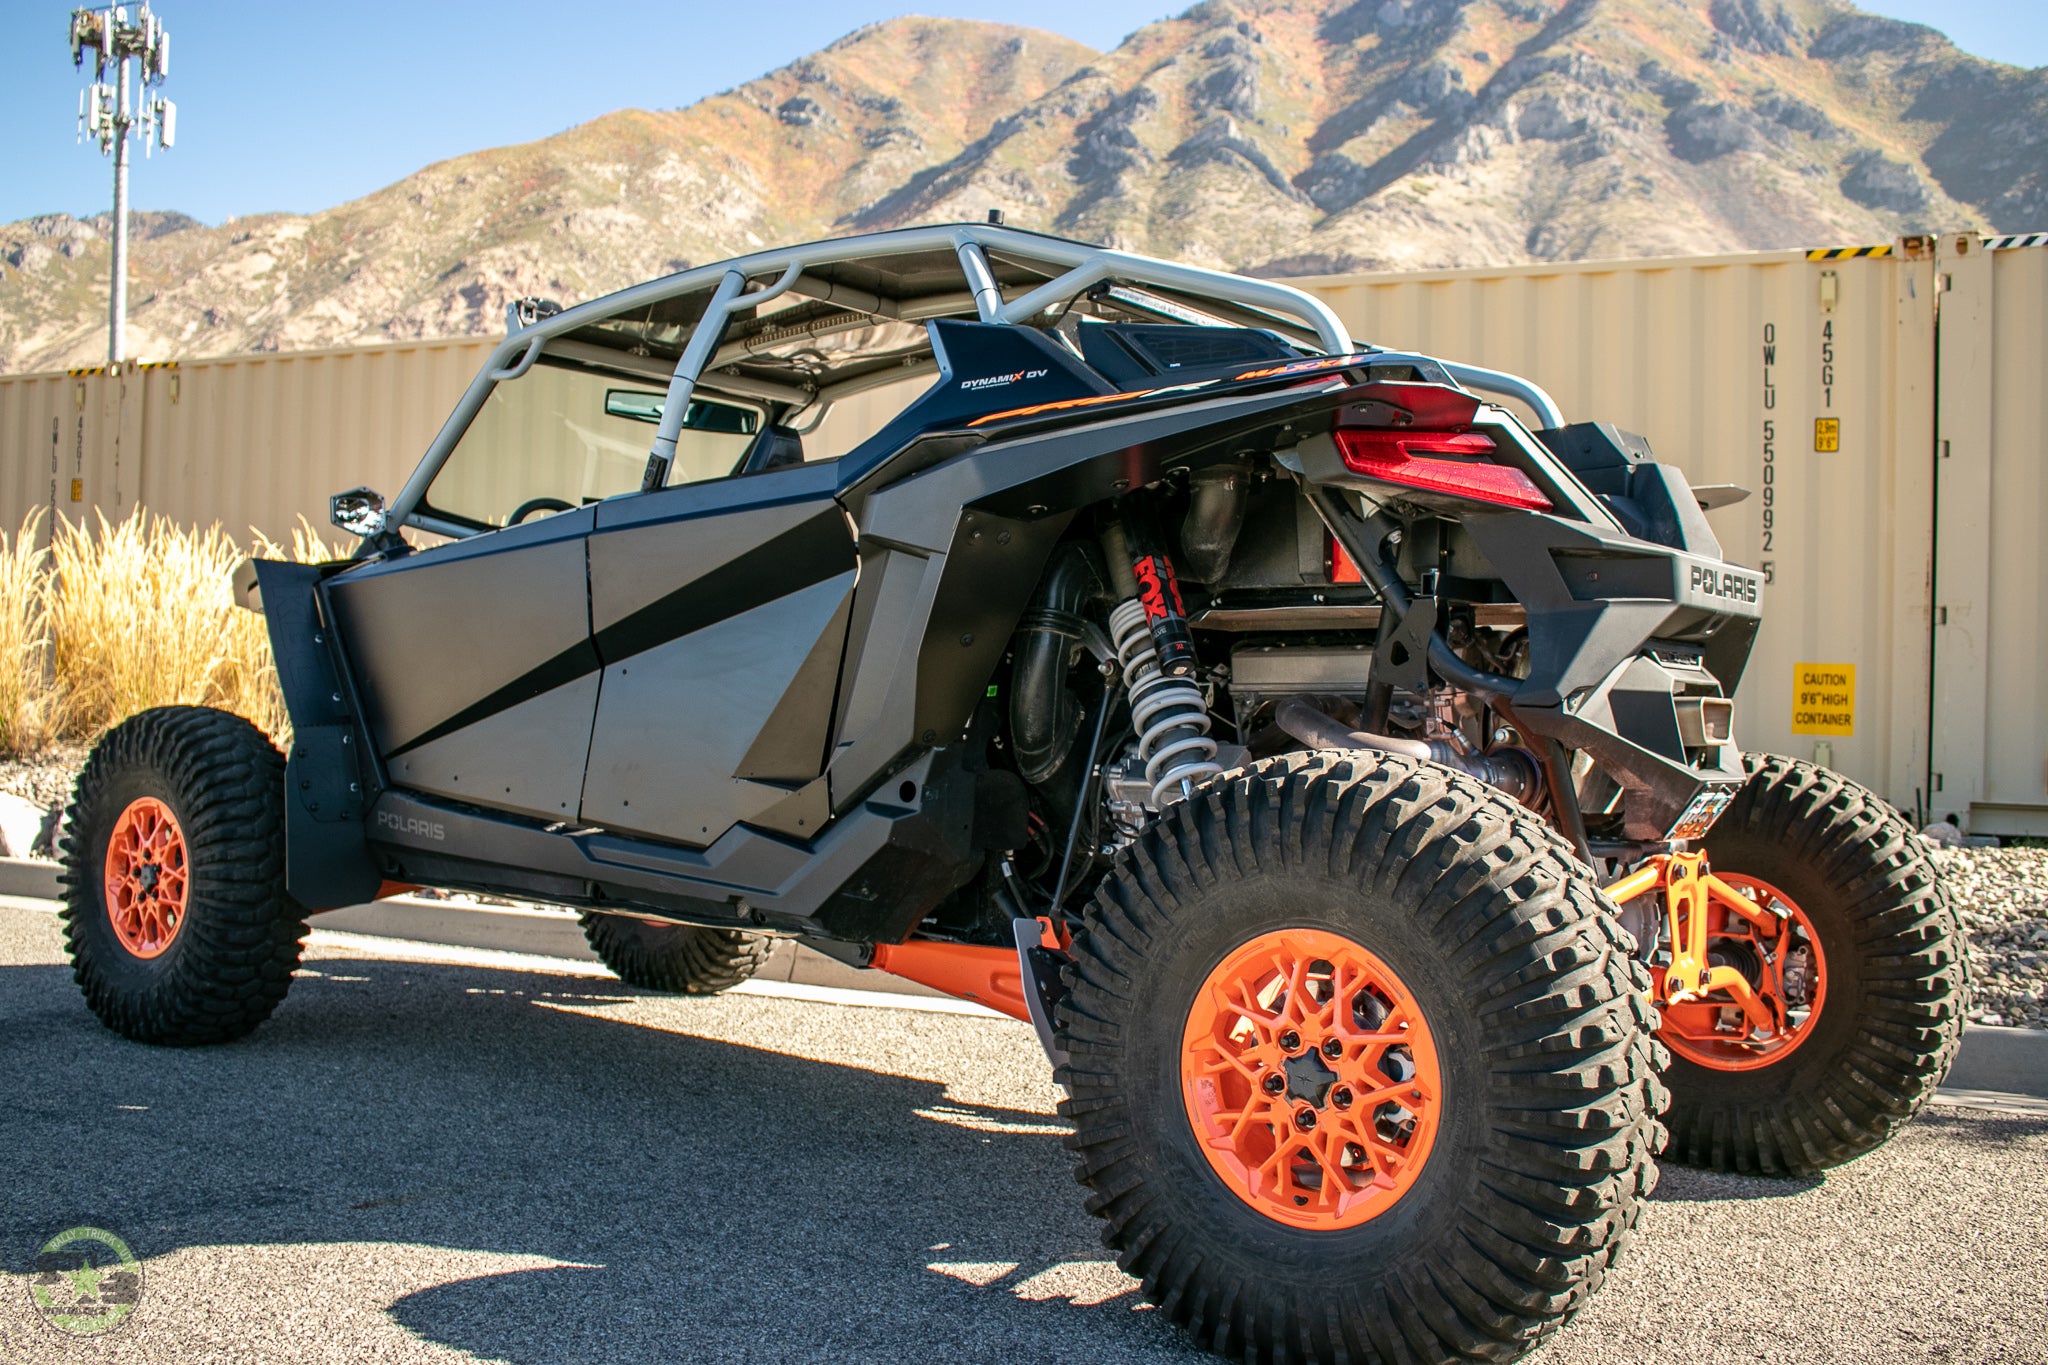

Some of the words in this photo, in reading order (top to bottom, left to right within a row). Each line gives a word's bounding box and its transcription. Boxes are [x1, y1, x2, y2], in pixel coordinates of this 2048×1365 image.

[961, 370, 1025, 389] DYNAMIX
[1026, 369, 1048, 379] DV
[1763, 323, 1776, 410] OWLU
[1822, 320, 1834, 408] 45G1
[1763, 420, 1775, 552] 550992
[1133, 555, 1168, 628] FOX
[1690, 565, 1757, 604] POLARIS
[1803, 673, 1846, 686] CAUTION
[1822, 694, 1848, 706] HIGH
[1795, 712, 1851, 726] CONTAINER
[378, 811, 445, 840] POLARIS
